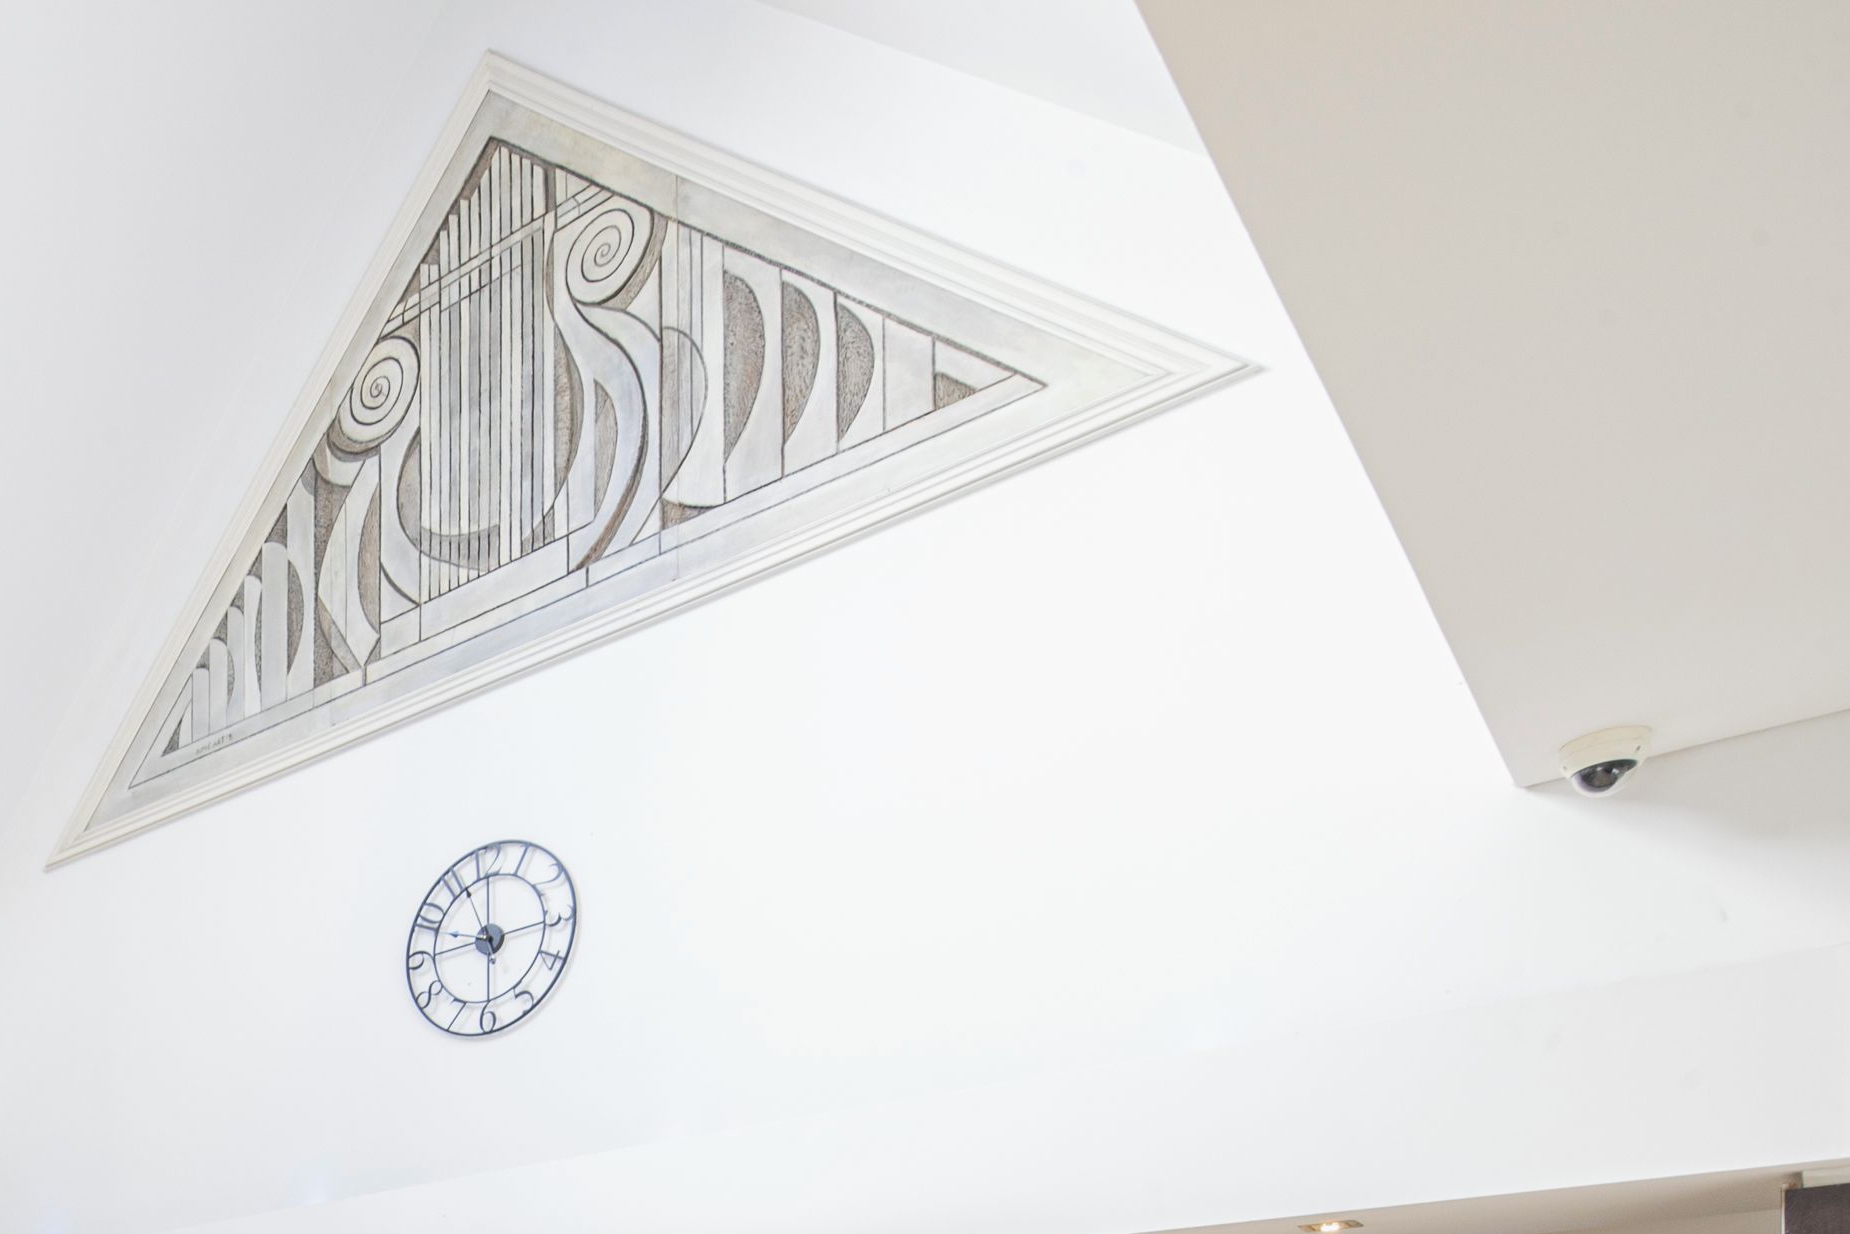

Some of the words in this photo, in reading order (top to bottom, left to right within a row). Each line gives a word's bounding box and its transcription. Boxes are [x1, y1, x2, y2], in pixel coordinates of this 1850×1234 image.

[532, 862, 564, 897] 2
[413, 901, 446, 932] 10
[543, 904, 574, 927] 3
[407, 950, 436, 971] 9
[538, 950, 566, 972] 4
[415, 979, 444, 1010] 8
[513, 987, 535, 1016] 5
[446, 997, 468, 1031] 7
[480, 999, 497, 1033] 6
